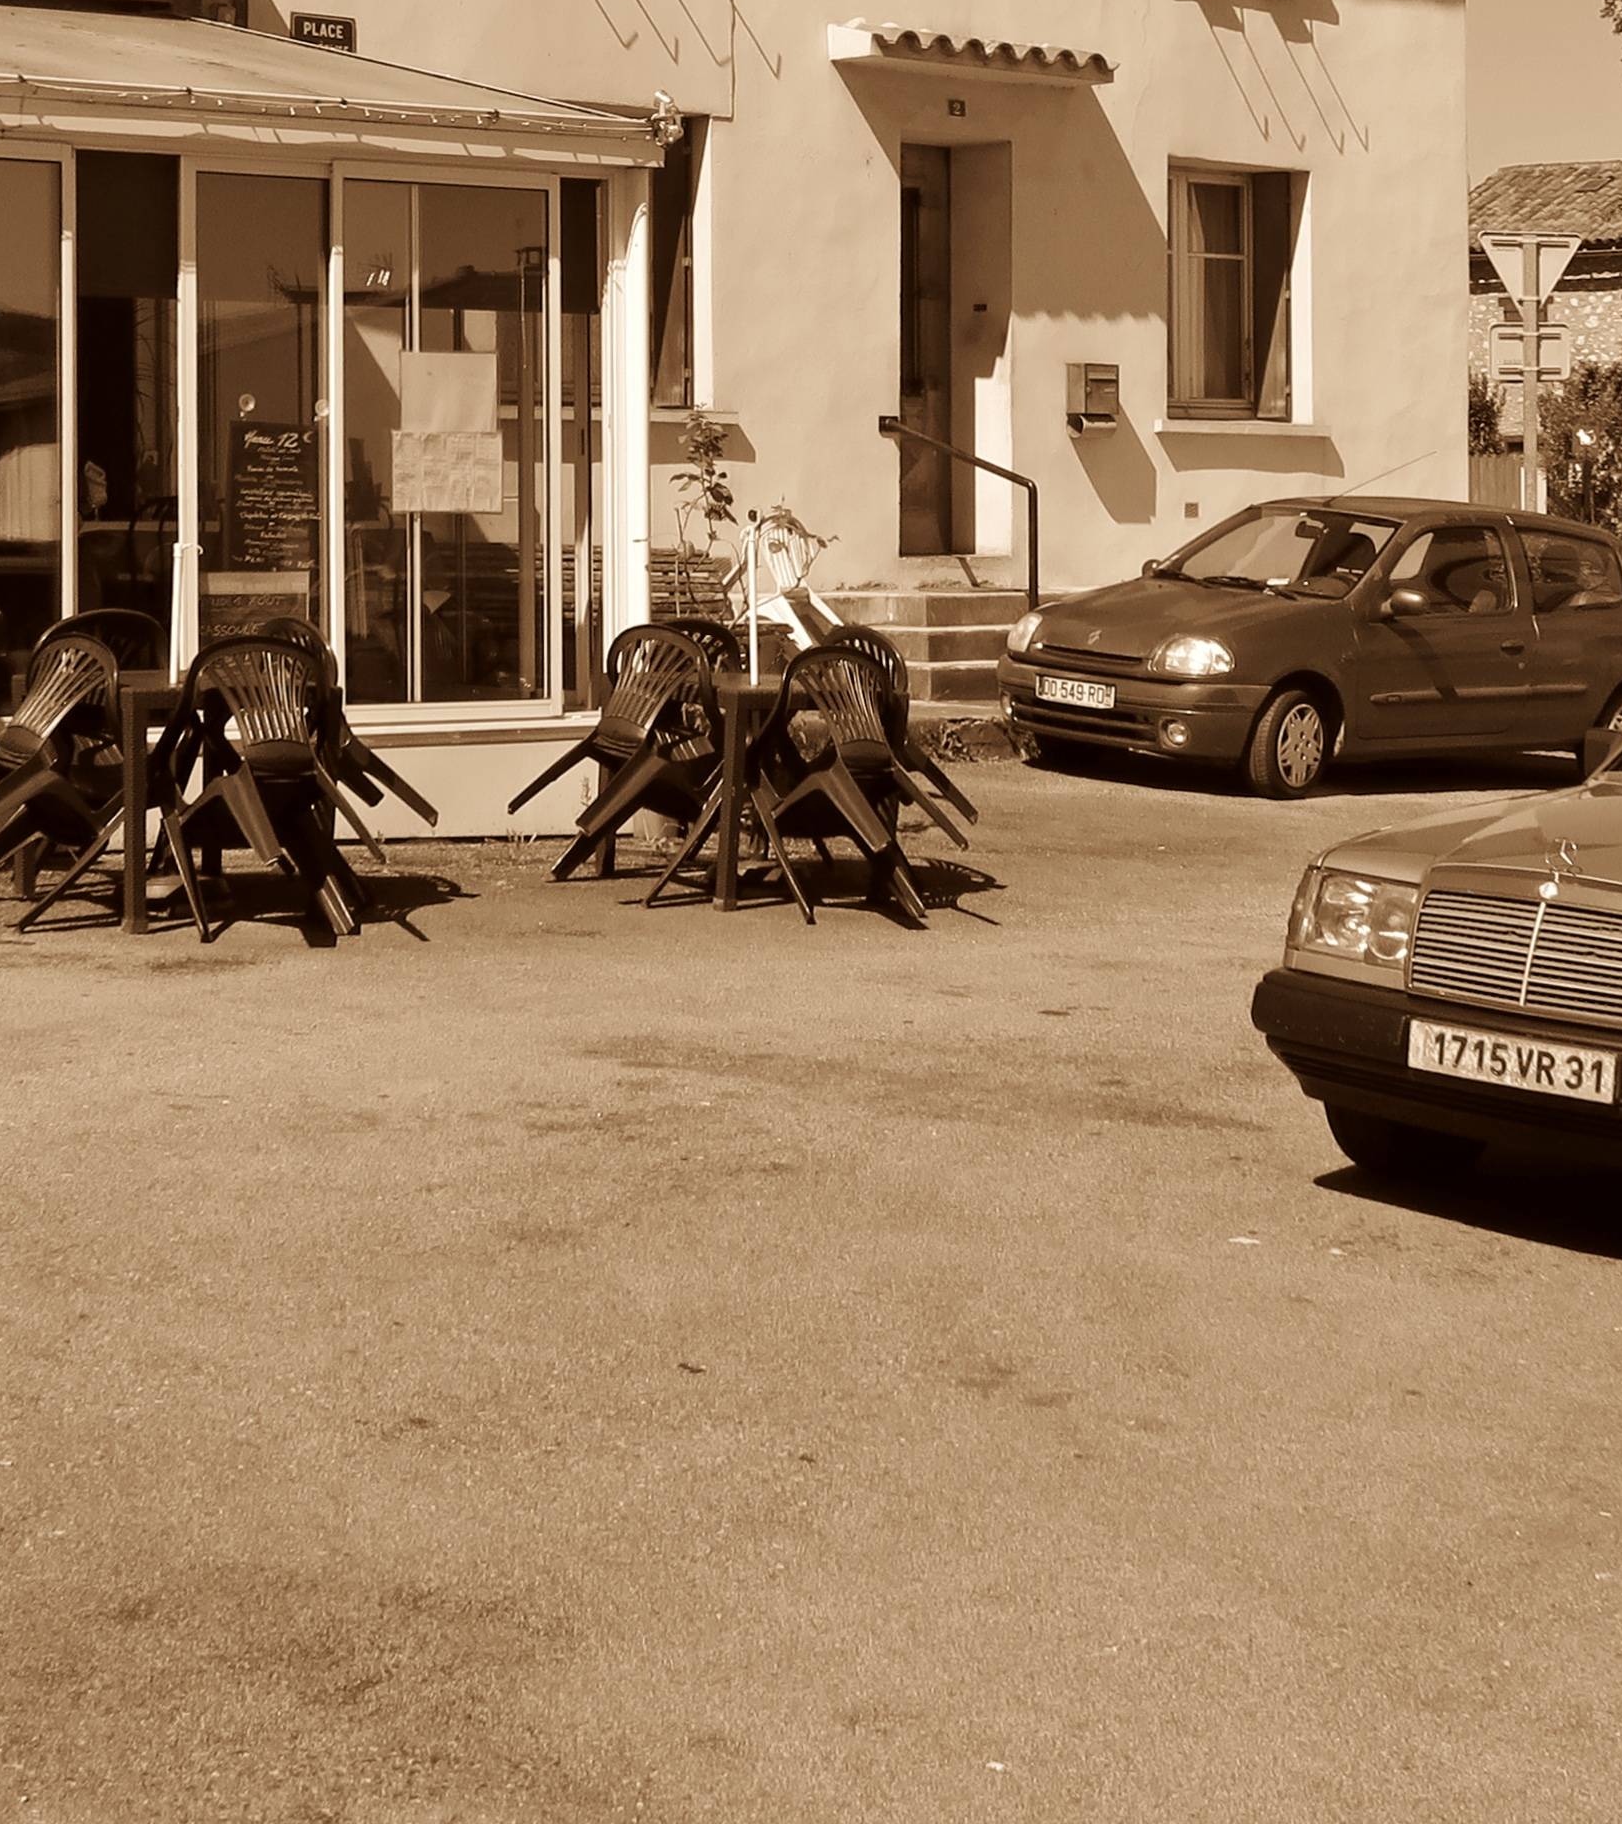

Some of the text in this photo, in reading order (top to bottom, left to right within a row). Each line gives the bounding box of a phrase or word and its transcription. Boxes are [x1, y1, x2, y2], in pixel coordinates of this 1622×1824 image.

[303, 21, 344, 40] PLACE
[952, 102, 961, 115] 2
[1434, 1032, 1604, 1094] 1715 VR 31
